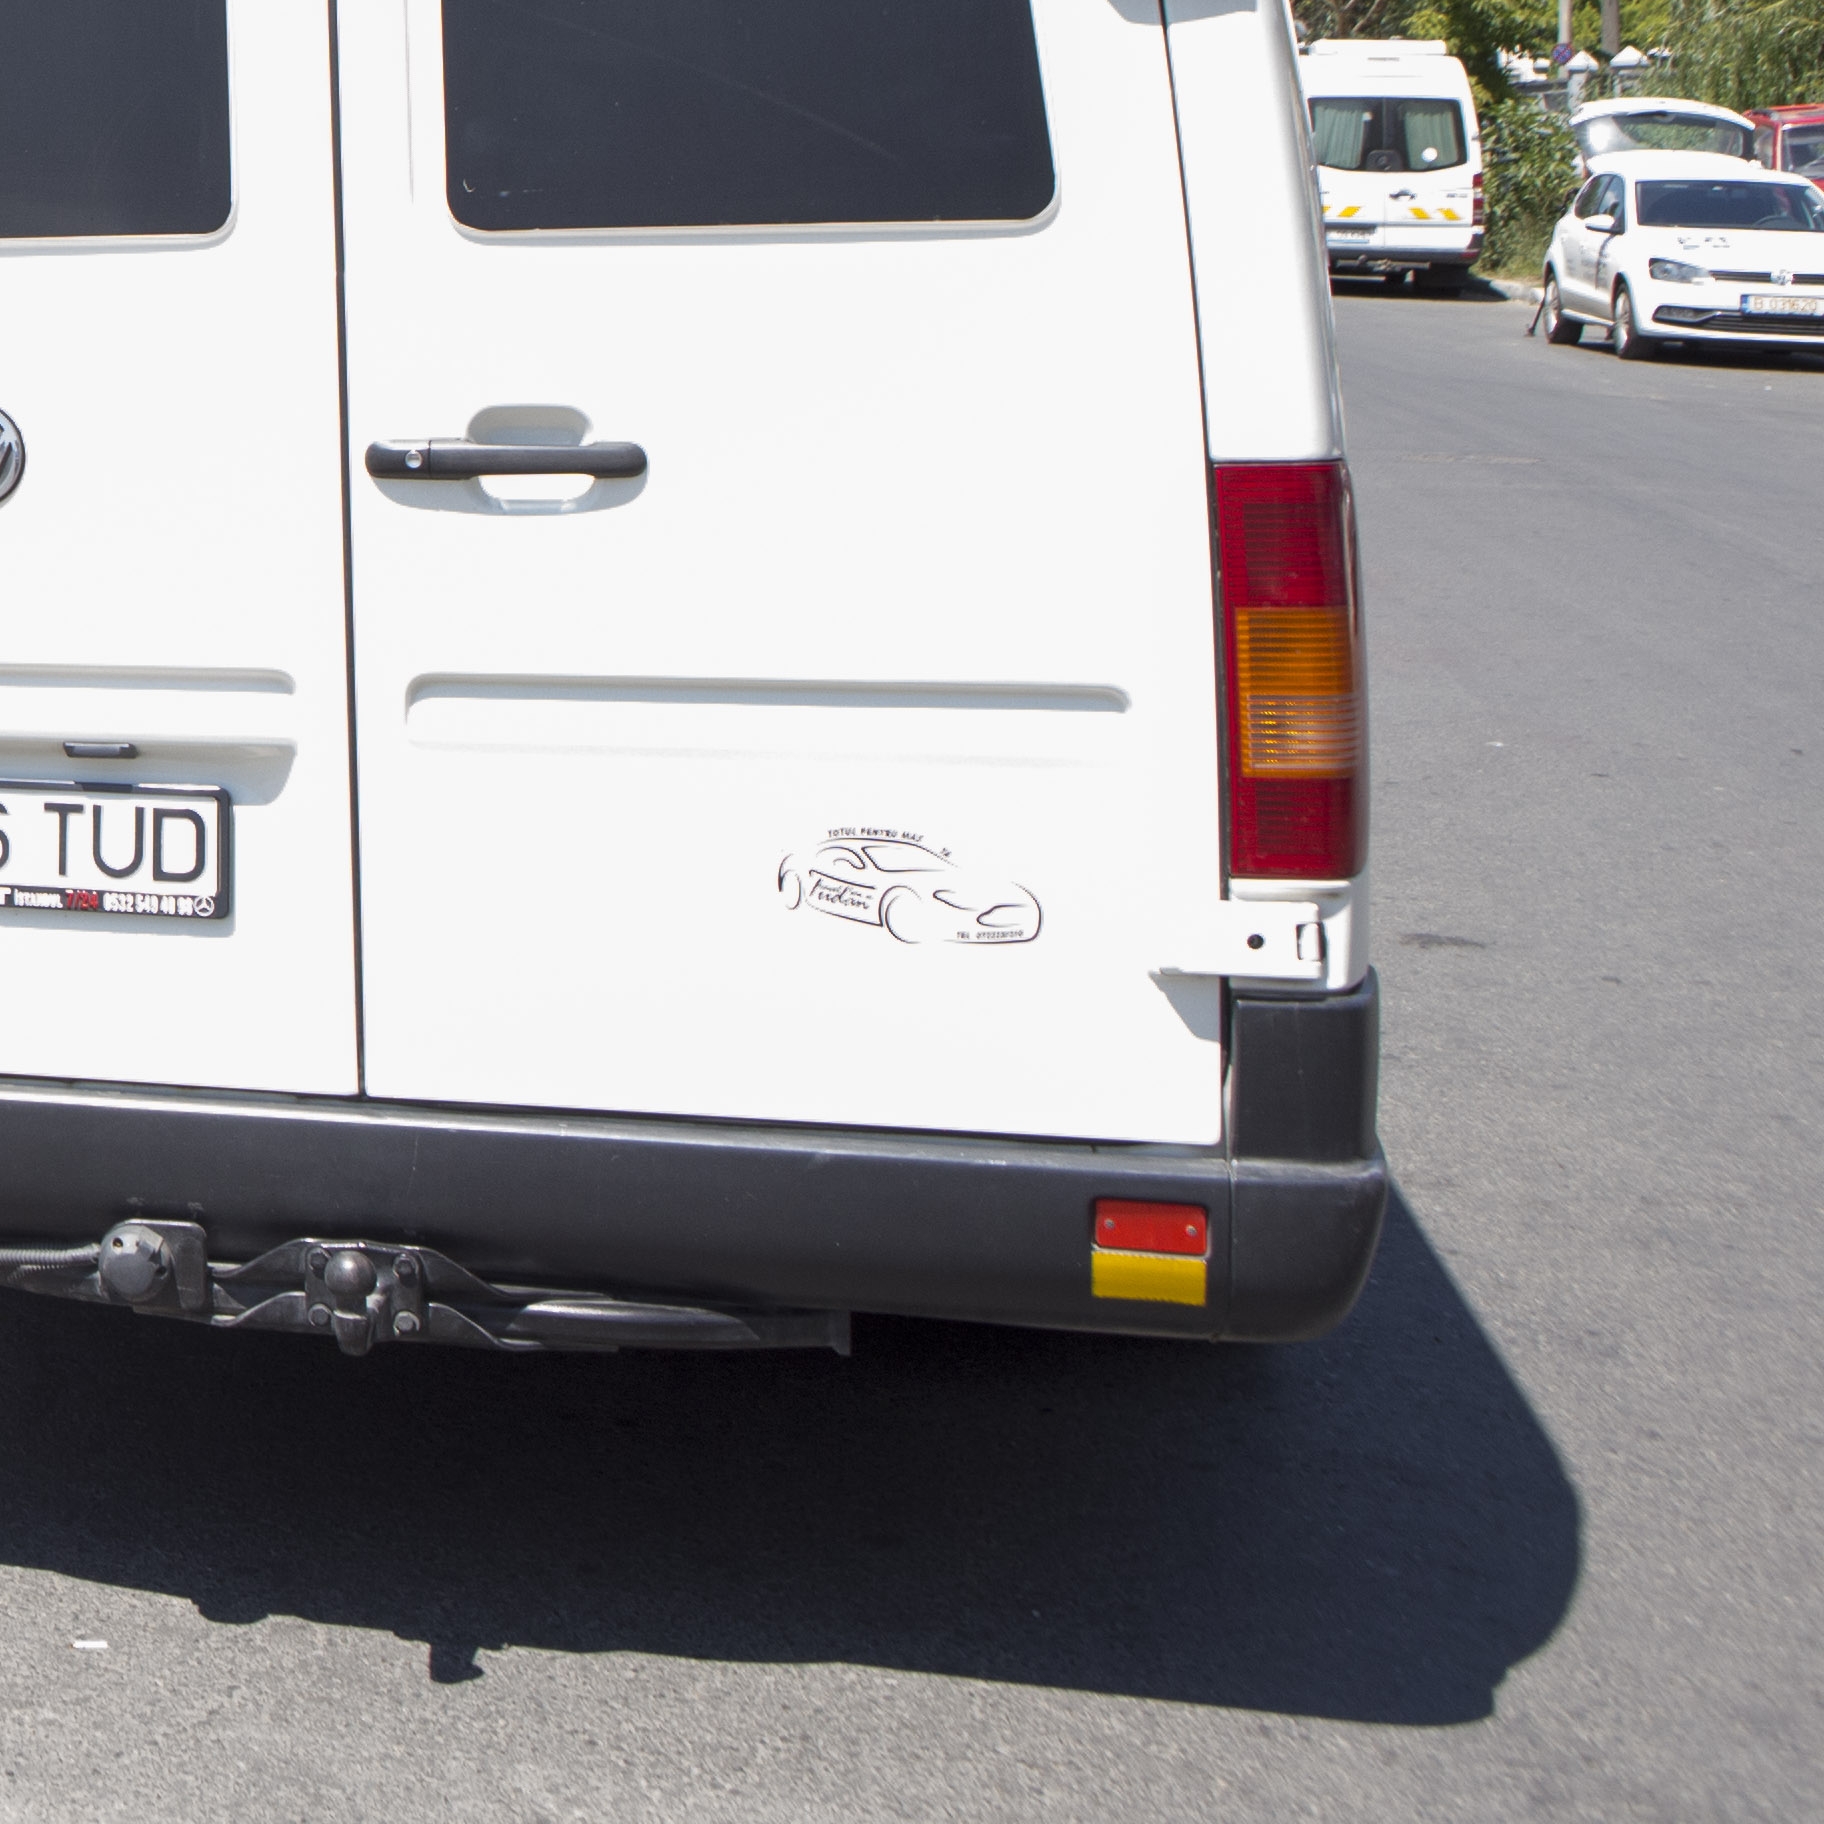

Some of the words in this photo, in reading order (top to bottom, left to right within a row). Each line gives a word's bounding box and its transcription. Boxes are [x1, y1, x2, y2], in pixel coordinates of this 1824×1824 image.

[44, 801, 206, 883] TUD
[827, 827, 857, 838] TOTUL
[860, 827, 899, 838] PENTRU
[65, 889, 99, 910] 7/24
